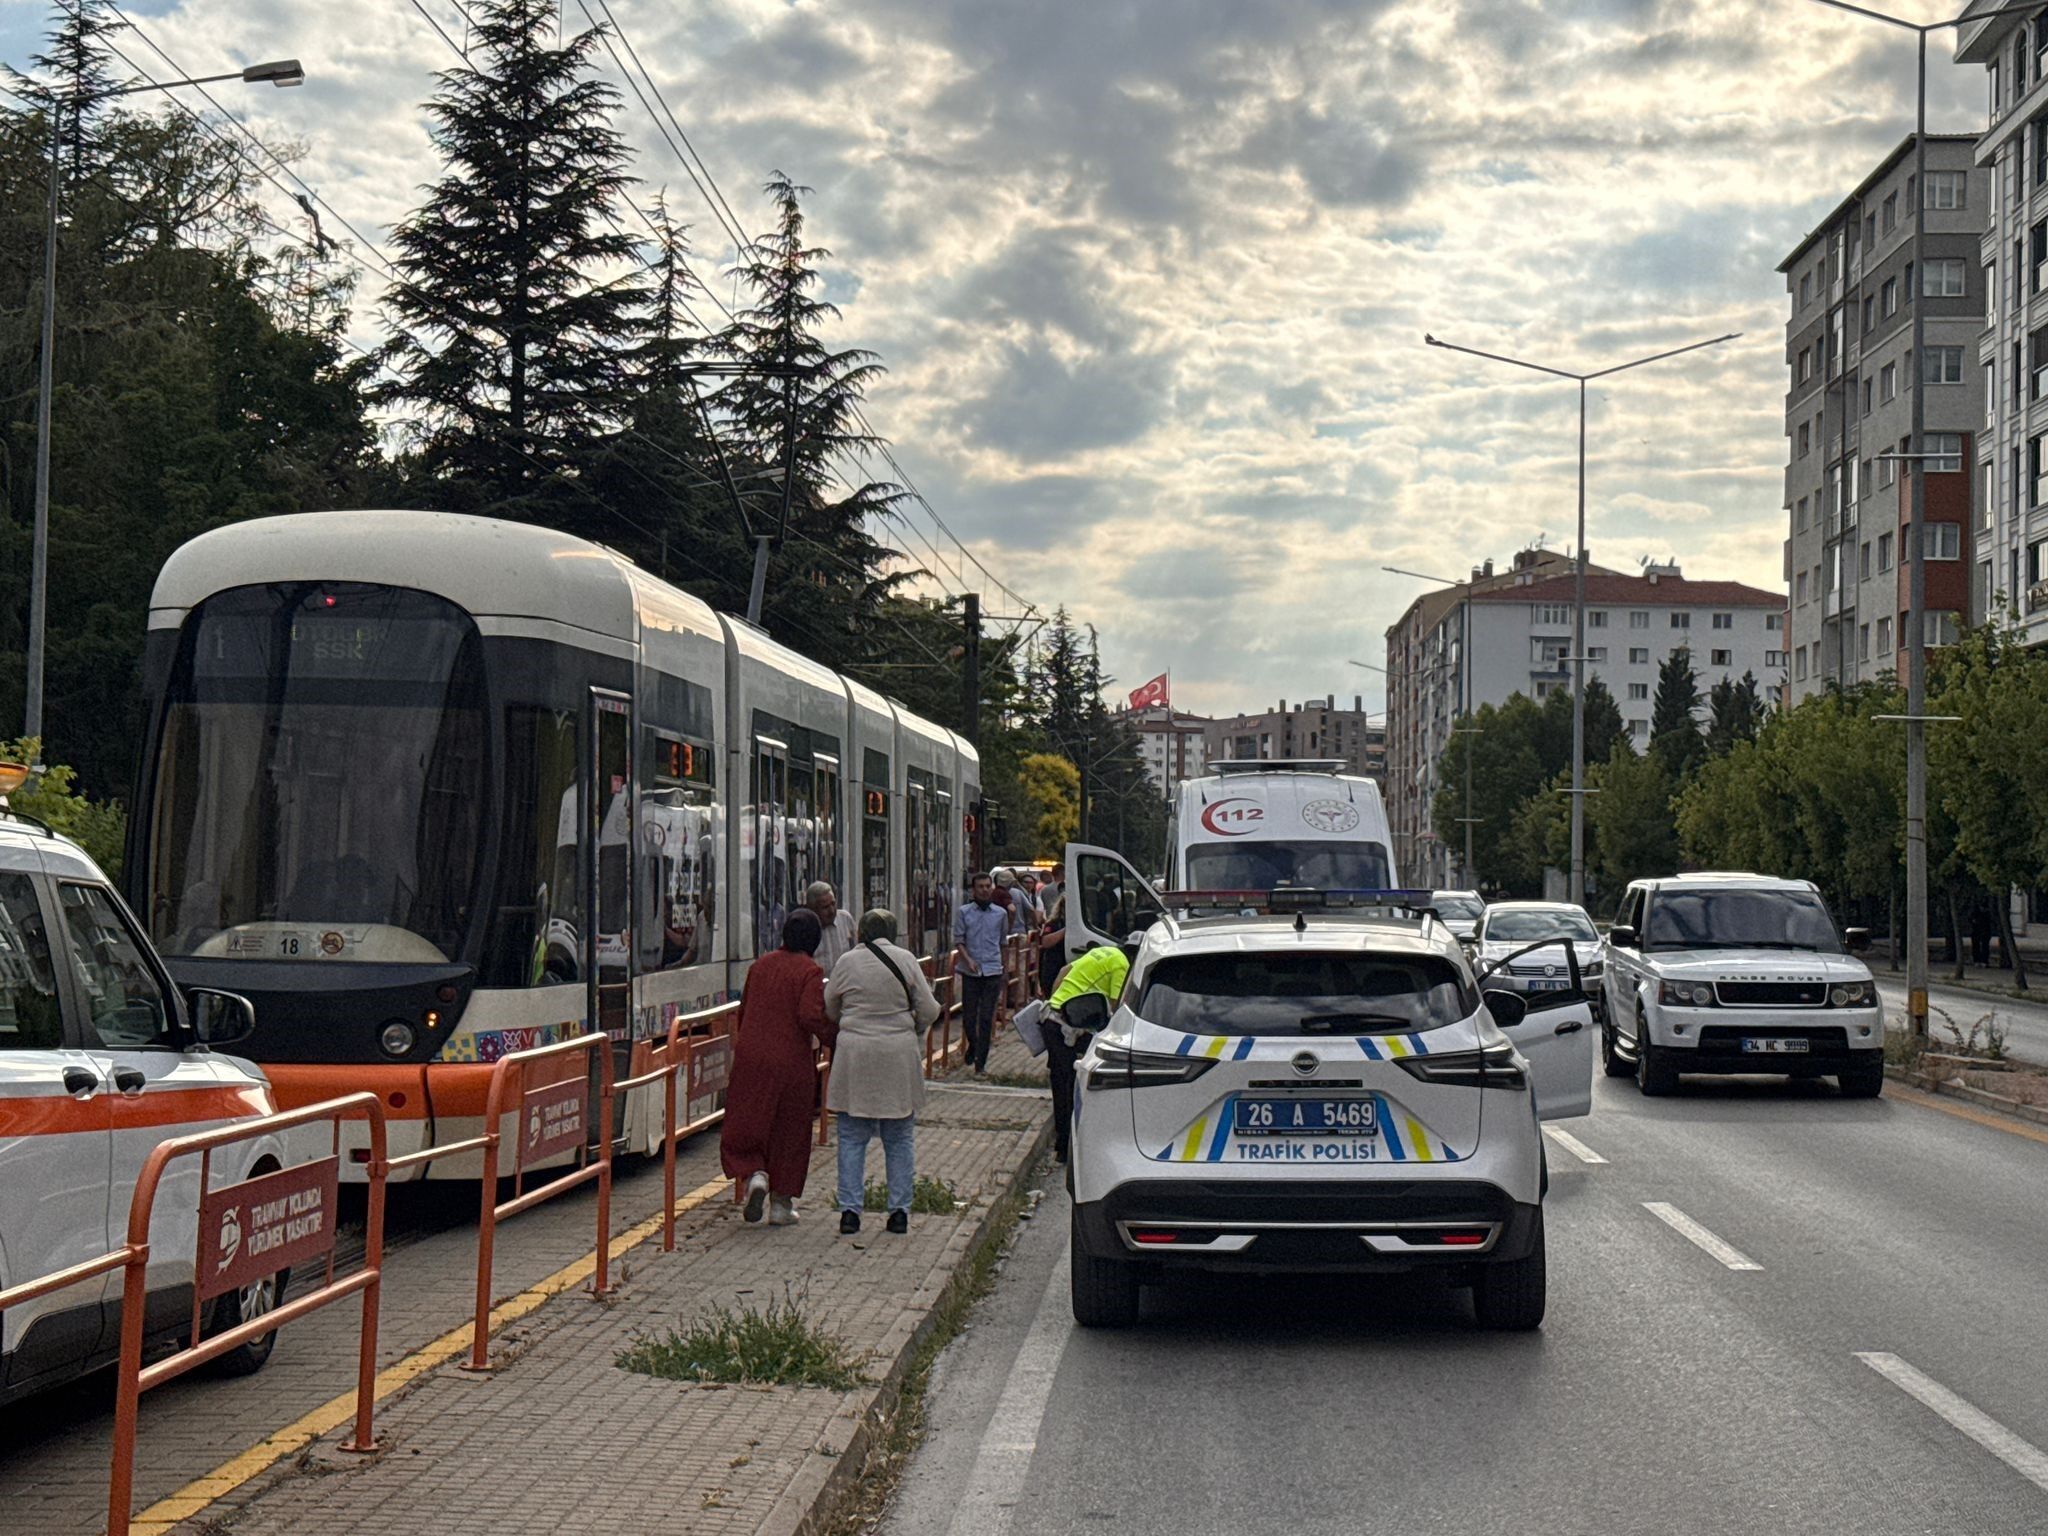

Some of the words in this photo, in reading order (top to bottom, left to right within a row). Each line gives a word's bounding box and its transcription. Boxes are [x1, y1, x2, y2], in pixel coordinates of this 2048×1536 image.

[313, 641, 364, 660] SSK
[1216, 808, 1264, 822] 112
[280, 938, 299, 955] 18
[1248, 1103, 1273, 1126] 26
[1292, 1103, 1304, 1126] A
[1323, 1103, 1373, 1126] 5469
[1237, 1139, 1306, 1159] TRAFİK
[1312, 1139, 1376, 1160] POLİSİ
